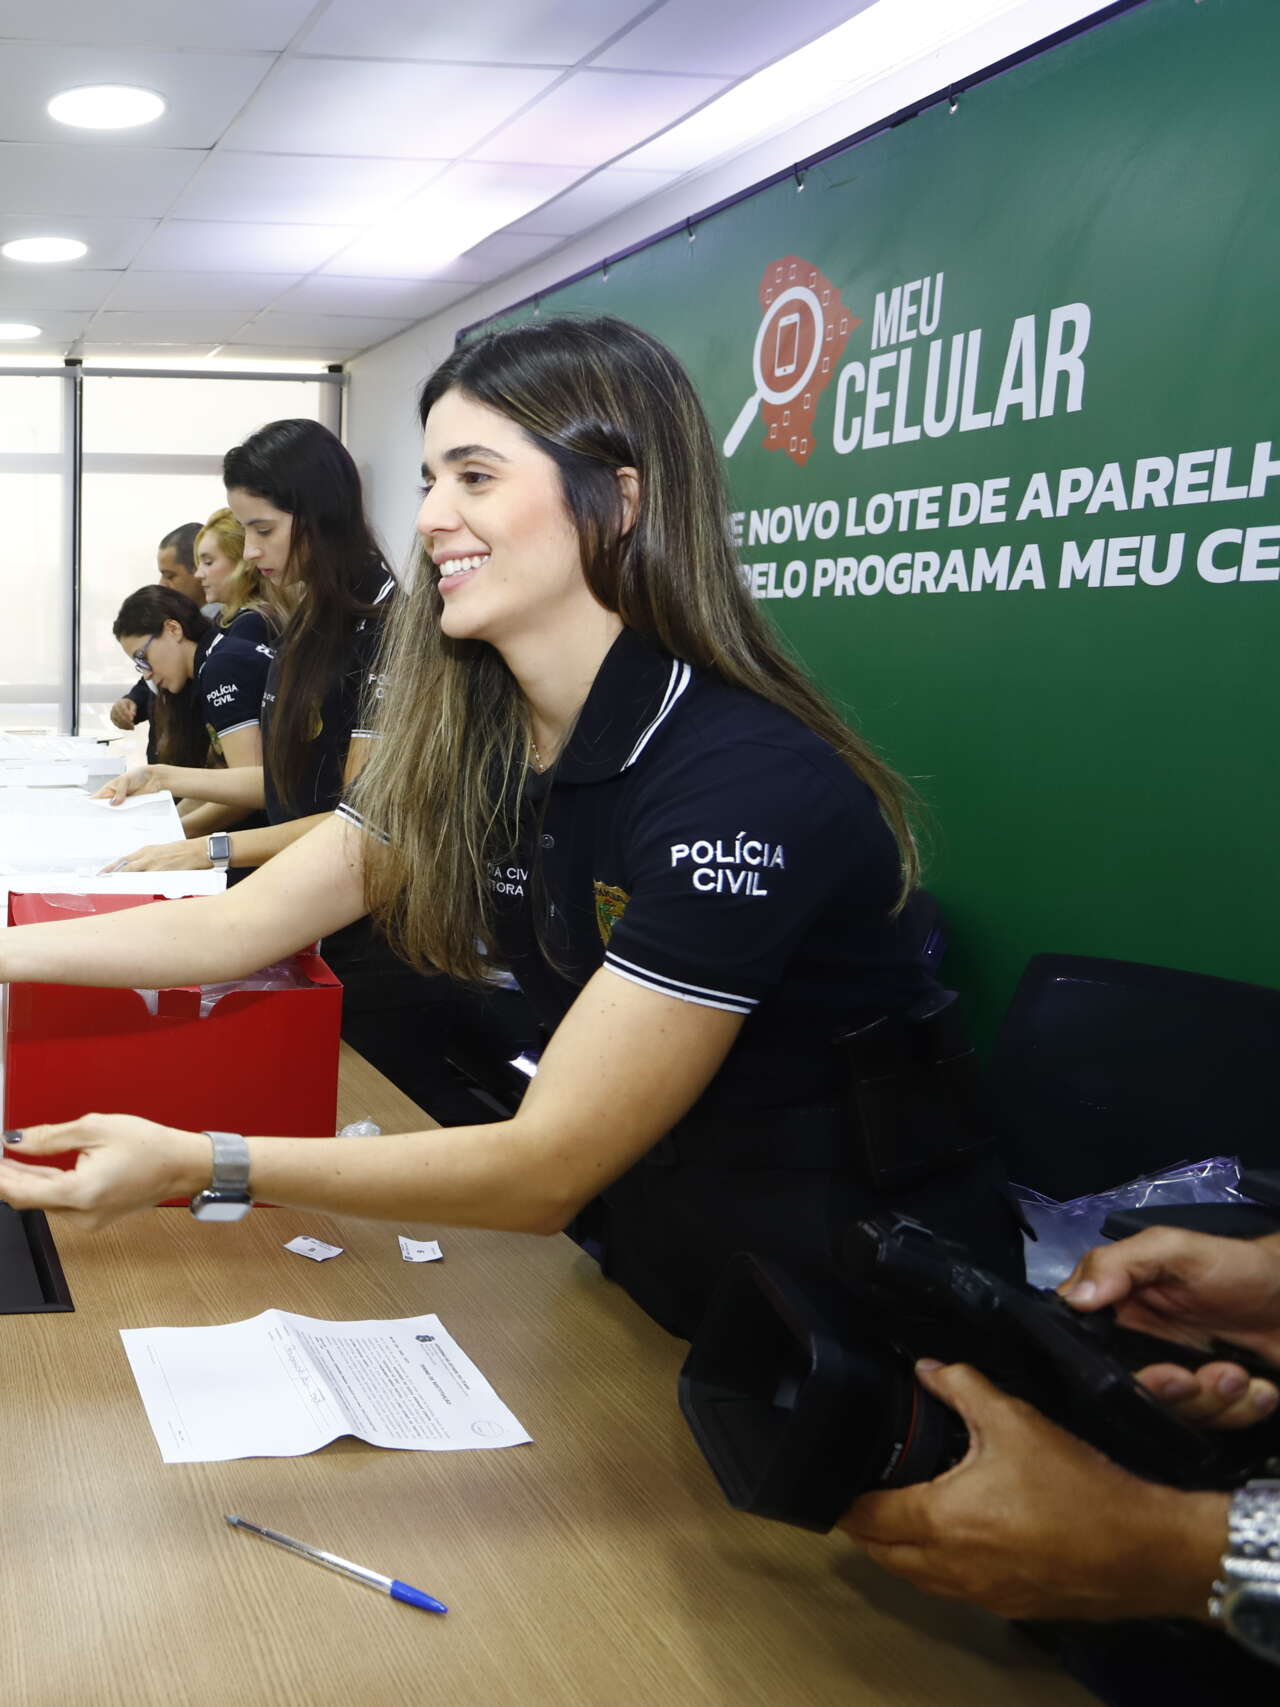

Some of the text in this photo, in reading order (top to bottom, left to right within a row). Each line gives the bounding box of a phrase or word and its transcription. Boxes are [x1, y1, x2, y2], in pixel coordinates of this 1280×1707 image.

[871, 272, 944, 350] MEU
[833, 302, 1091, 455] CELULAR
[748, 500, 840, 546] NOVO
[845, 486, 943, 536] LOTE
[947, 477, 1011, 527] DE
[812, 544, 1046, 597] PROGRAMA
[1058, 533, 1186, 589] MEU
[206, 684, 239, 702] POLÍCIA
[213, 694, 236, 707] CIVIL
[671, 832, 785, 869] POLÍCIA
[693, 868, 768, 896] CIVIL
